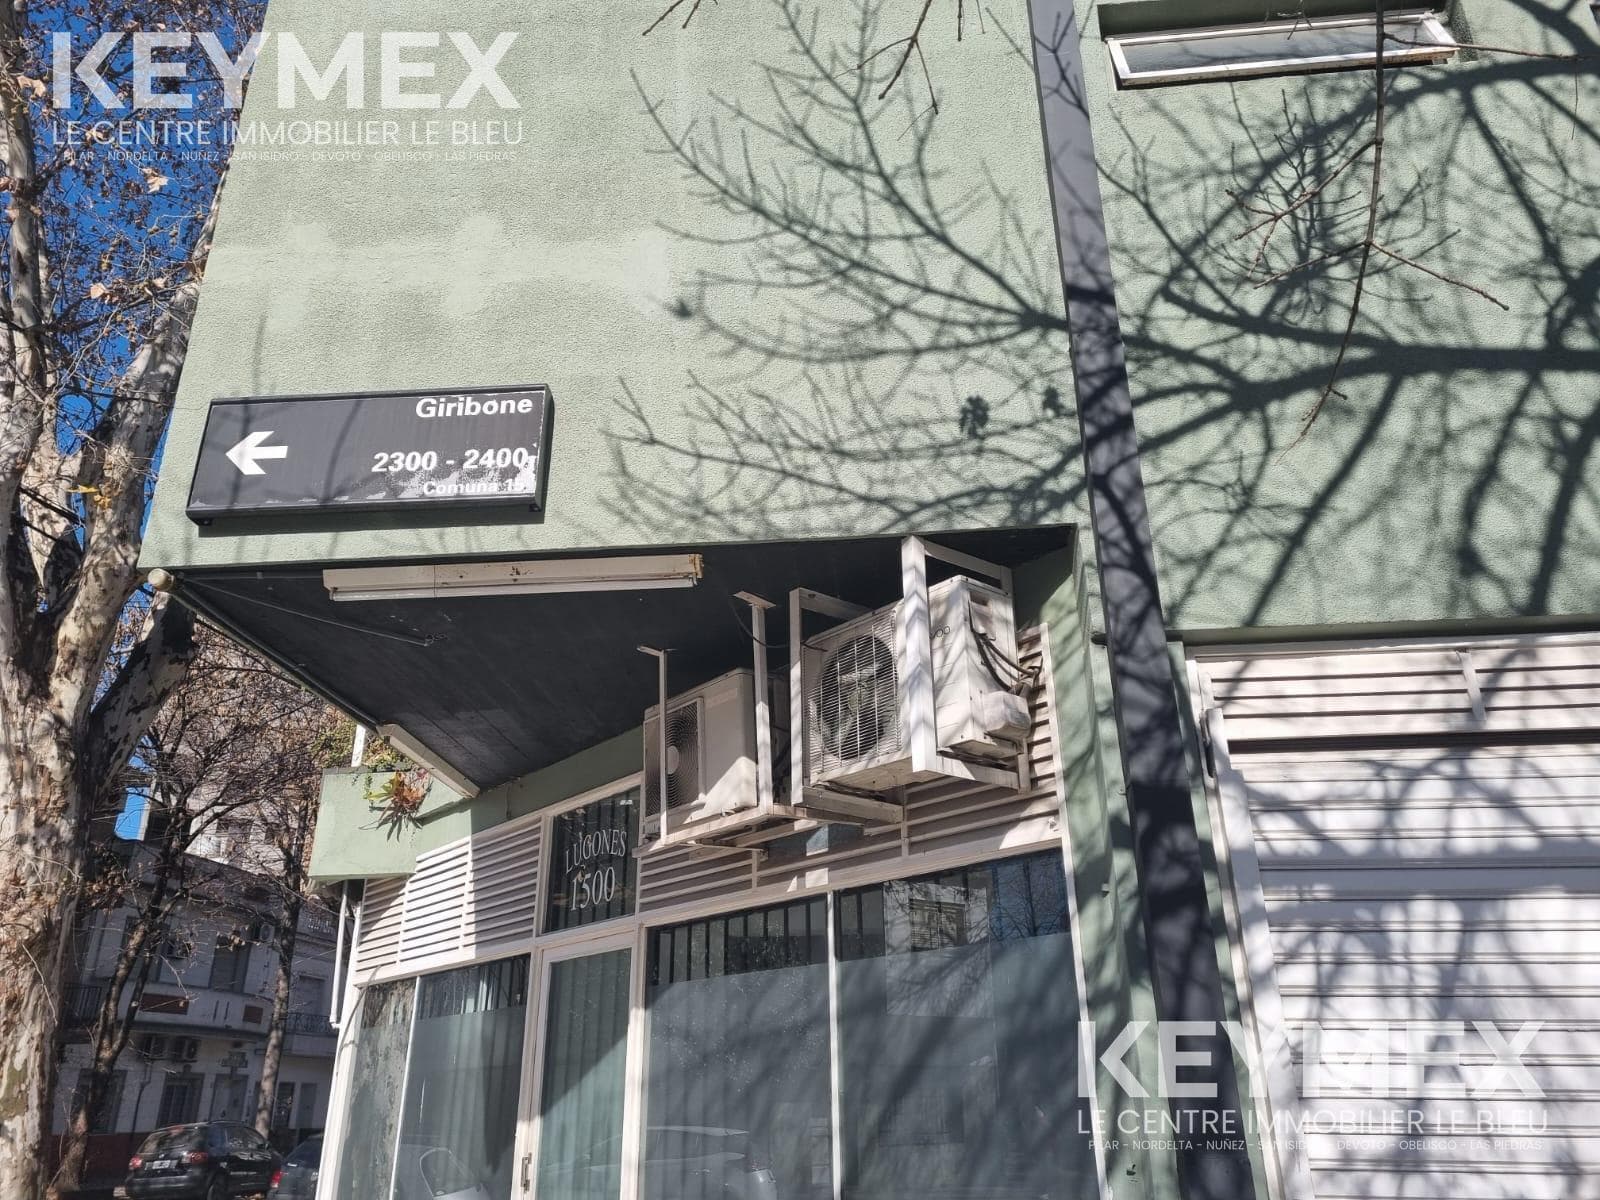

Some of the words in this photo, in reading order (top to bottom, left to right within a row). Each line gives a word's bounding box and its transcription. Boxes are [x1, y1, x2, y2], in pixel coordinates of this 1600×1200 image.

[415, 396, 534, 419] Giribone
[371, 450, 438, 473] 2300
[462, 447, 529, 470] 2400
[423, 480, 498, 495] Comuna
[564, 828, 628, 874] LUGONES
[570, 866, 616, 911] 1500
